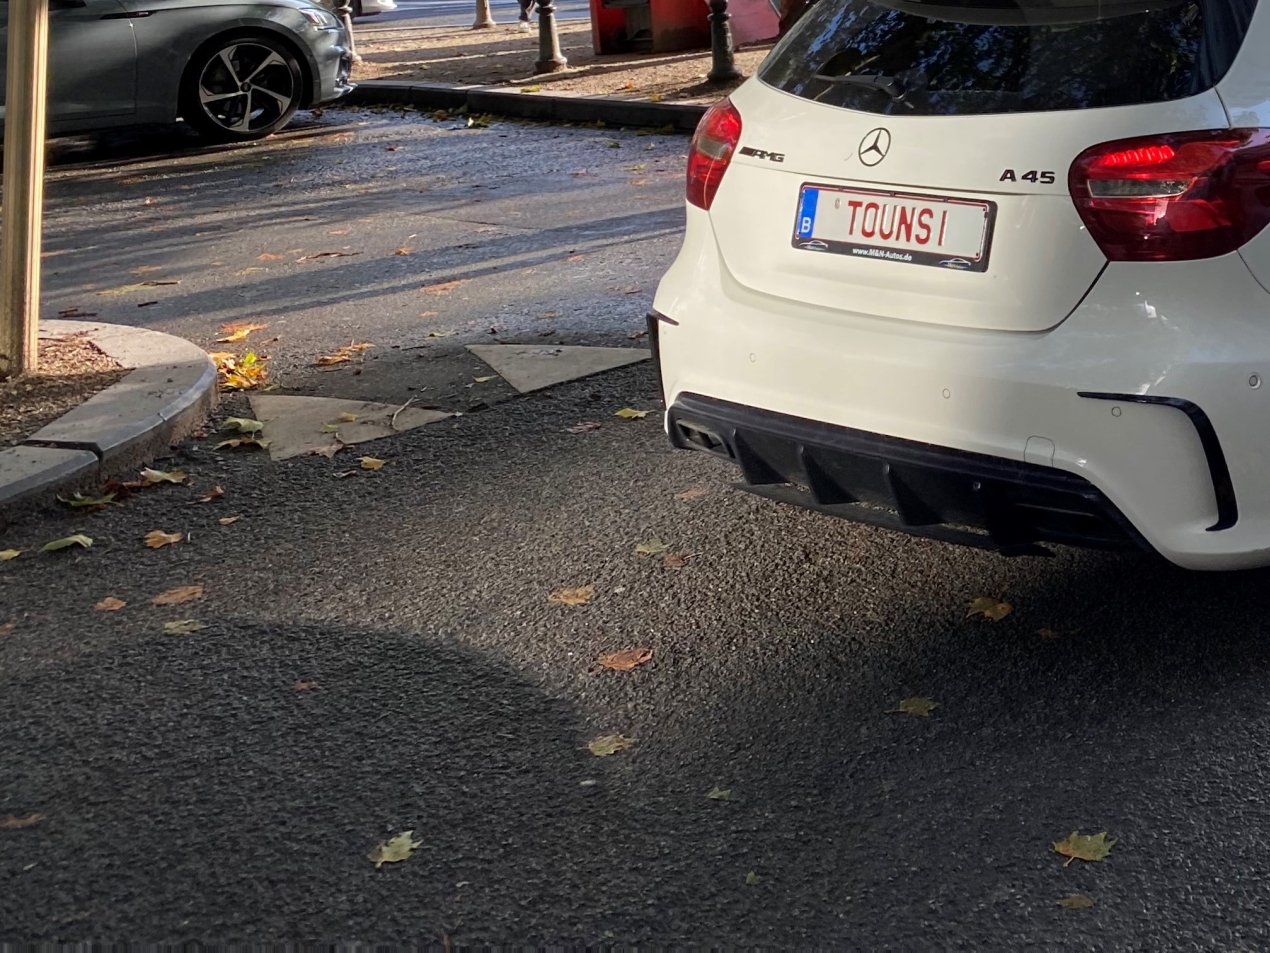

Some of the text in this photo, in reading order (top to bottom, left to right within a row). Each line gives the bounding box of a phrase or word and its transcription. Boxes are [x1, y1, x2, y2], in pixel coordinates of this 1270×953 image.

[752, 149, 785, 163] AMG
[999, 169, 1055, 184] A 45
[801, 200, 948, 247] B TOUNSI
